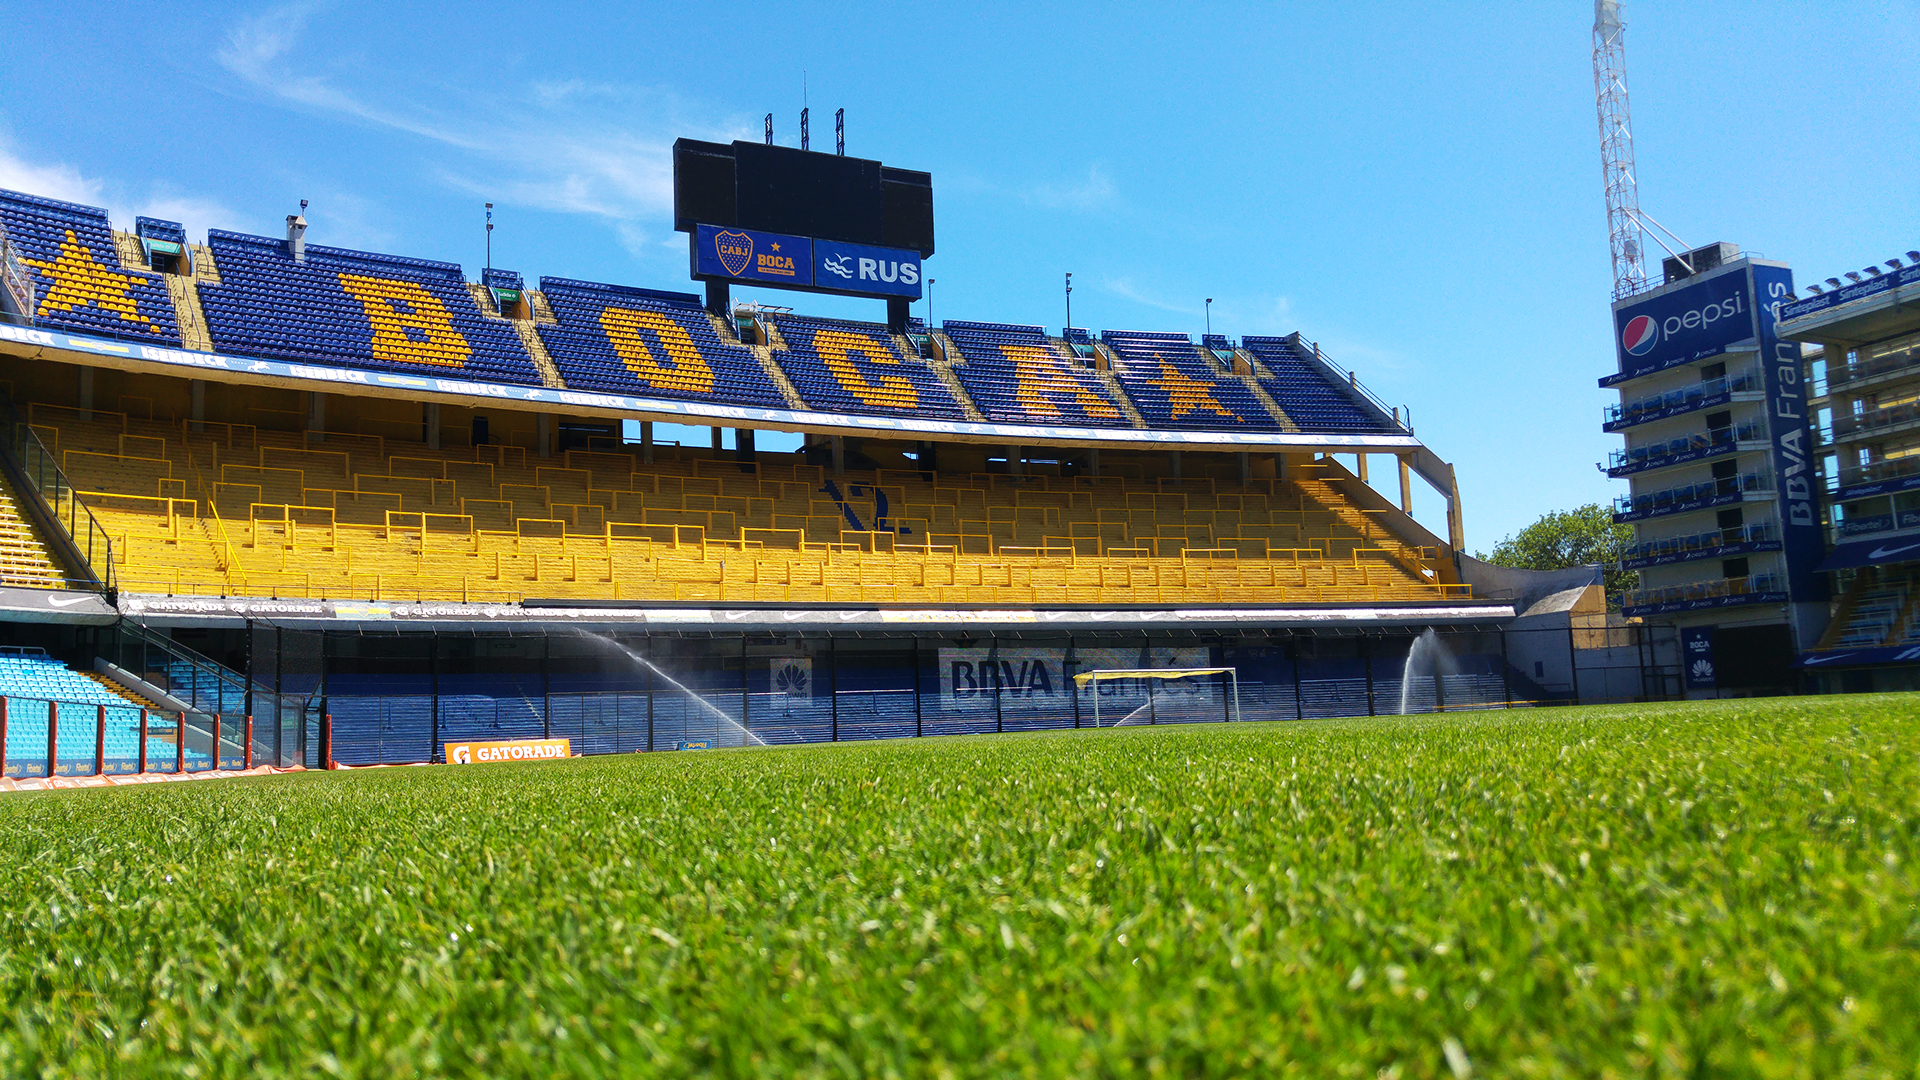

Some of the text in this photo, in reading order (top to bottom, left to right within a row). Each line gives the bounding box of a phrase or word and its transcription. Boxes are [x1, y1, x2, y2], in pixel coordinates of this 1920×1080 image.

[720, 245, 748, 257] CABJ
[757, 253, 795, 269] BOCA
[858, 257, 919, 285] RUS
[1838, 277, 1889, 301] Sinteplast
[1663, 290, 1741, 341] pepsi
[1784, 295, 1831, 317] Sinteplast
[141, 346, 229, 368] ISENBECK
[1764, 282, 1813, 526] BBVA Franés
[150, 601, 226, 612] GATORADE
[251, 604, 322, 613] GATORADE
[413, 606, 479, 616] GATORADE
[1689, 641, 1710, 649] BOCA
[952, 657, 1200, 698] BBVA Fanés
[477, 745, 565, 761] GATORADE
